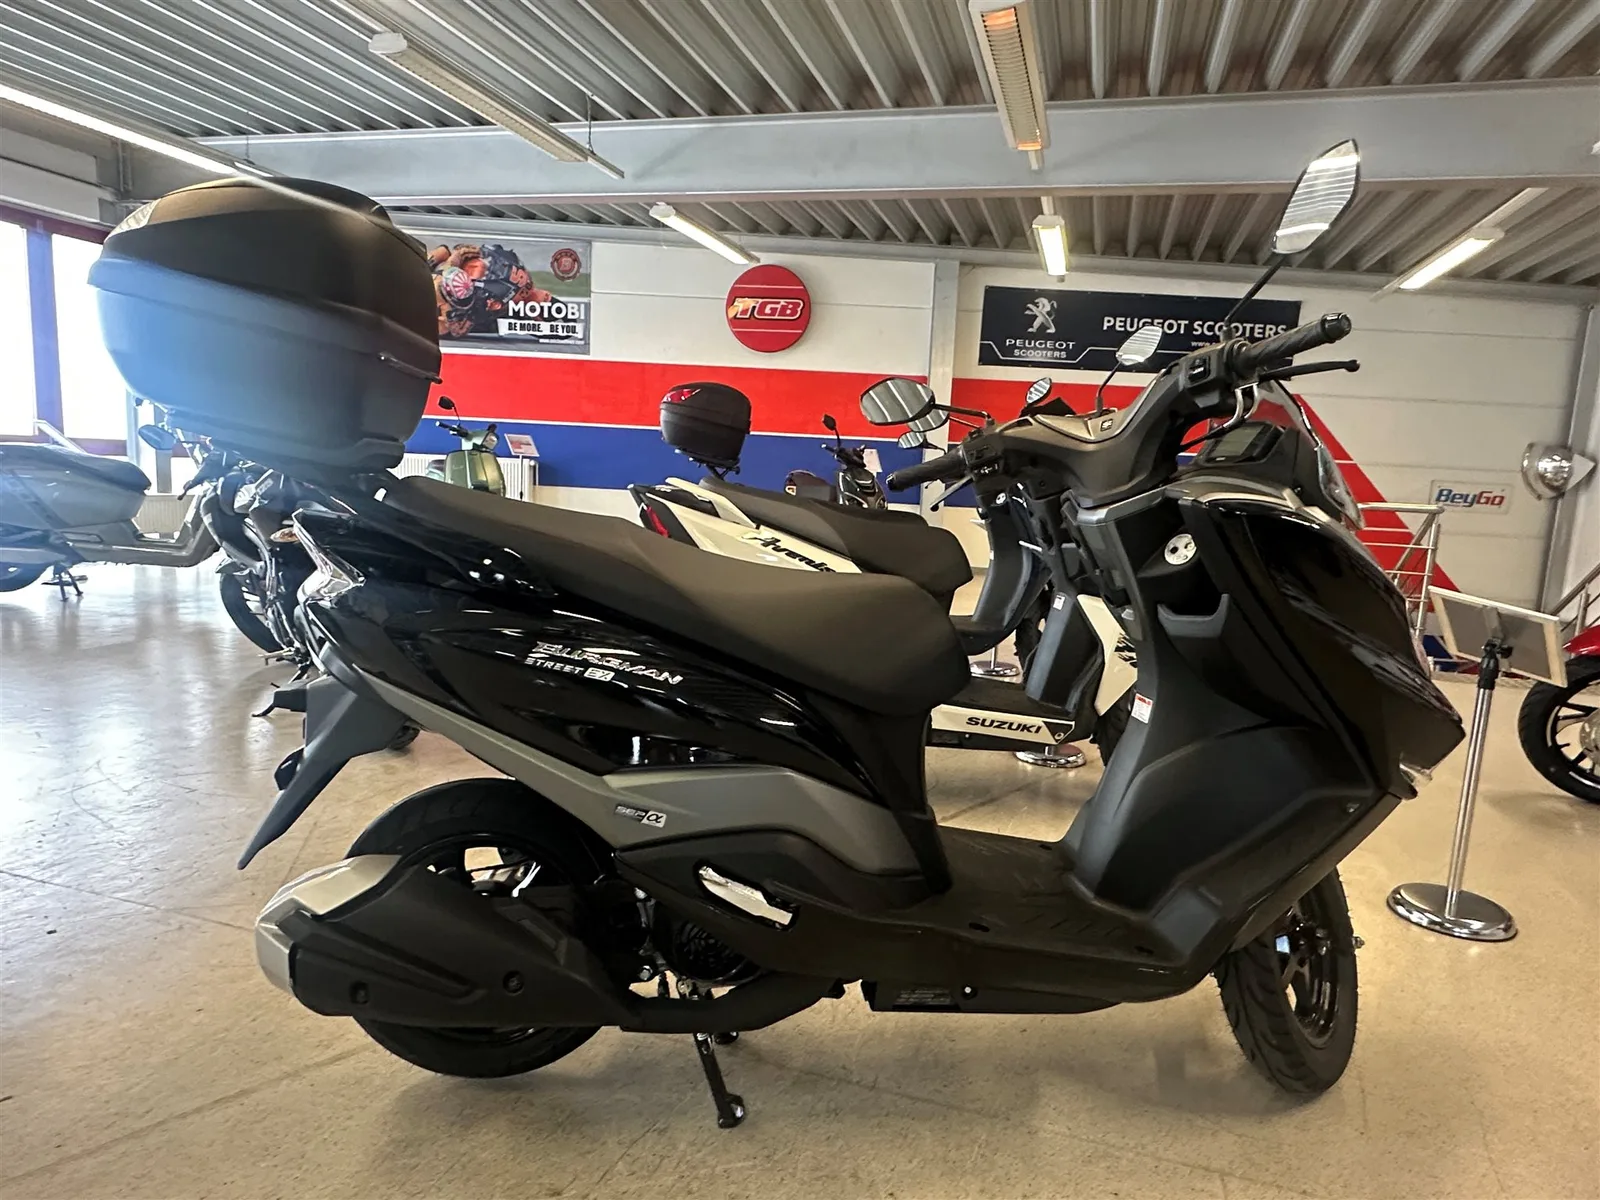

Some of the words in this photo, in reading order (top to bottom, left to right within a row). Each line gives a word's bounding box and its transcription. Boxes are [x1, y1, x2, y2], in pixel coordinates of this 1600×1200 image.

[508, 300, 585, 319] MOTOBI
[733, 298, 804, 319] TGB
[508, 321, 518, 332] BE
[549, 323, 560, 334] BE
[1005, 338, 1076, 350] PEUGEOT
[1013, 348, 1067, 359] SCOOTERS
[1435, 488, 1505, 507] BeyGo
[524, 657, 584, 675] STREET
[965, 716, 1043, 734] SUZUKI
